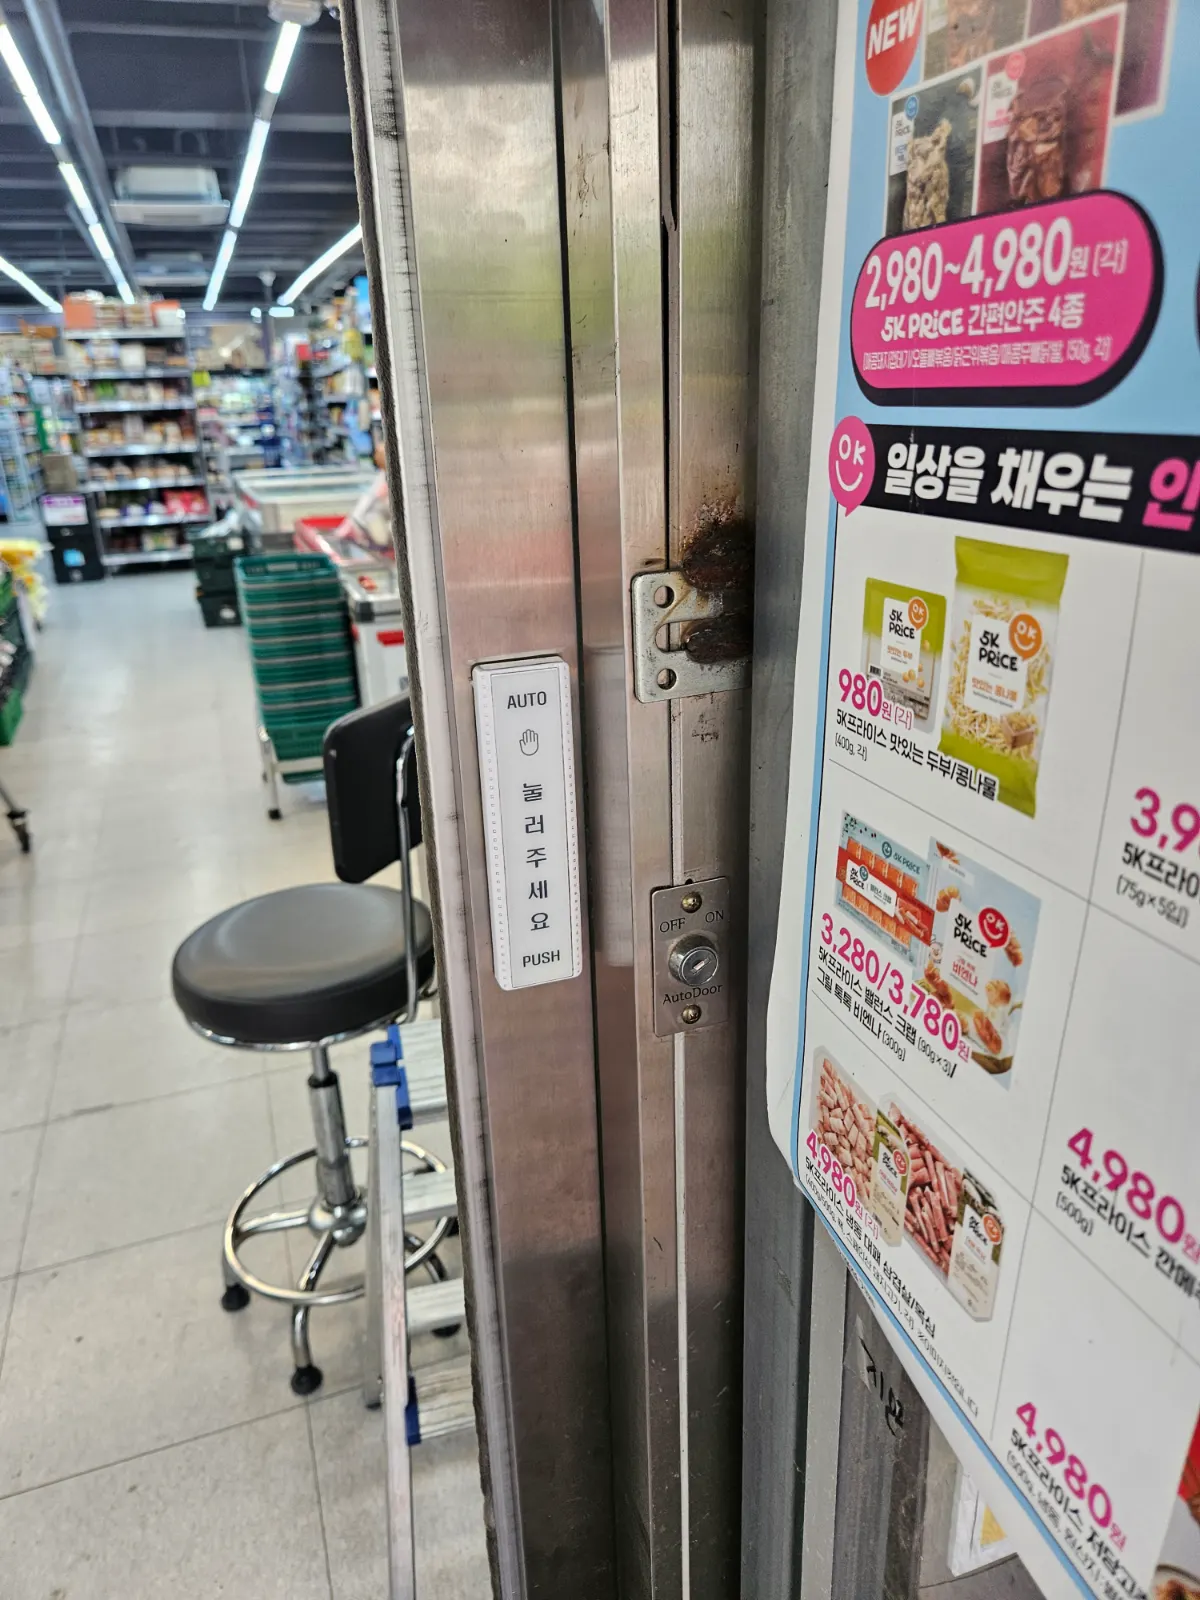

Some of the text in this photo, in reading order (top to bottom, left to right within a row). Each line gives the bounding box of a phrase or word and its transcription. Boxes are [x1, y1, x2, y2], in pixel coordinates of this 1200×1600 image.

[867, 0, 920, 60] NEW
[880, 314, 906, 342] 5K
[967, 298, 1046, 337] 간편안주
[1048, 292, 1086, 330] 4종
[884, 442, 986, 504] 일상을
[990, 447, 1135, 523] 채우는
[889, 609, 903, 623] 5K
[979, 630, 1000, 649] 5K
[507, 691, 547, 710] AUTO
[838, 668, 892, 722] 980원
[894, 706, 913, 731] (각)
[836, 708, 998, 801] 5K프라이스 맛있는 두부/콩나물
[1130, 787, 1200, 853] 3,9
[521, 782, 551, 932] 눌러주세요
[659, 909, 724, 934] OFF ON
[954, 913, 972, 933] 5K
[522, 949, 561, 968] PUSH
[820, 912, 970, 1064] 3,280/3,780원
[662, 983, 723, 1005] AutoDoor
[816, 966, 907, 1062] 그릴 톡톡 비엔나 (300g)
[818, 946, 863, 998] 5K프라이스
[864, 986, 894, 1025] 밸런스
[895, 1013, 917, 1046] 크랩
[805, 1131, 864, 1221] 4,980원
[805, 1155, 845, 1217] 5K프라이스
[1060, 1163, 1152, 1259] 5K프라이스
[1010, 1427, 1084, 1534] 5K프라이스
